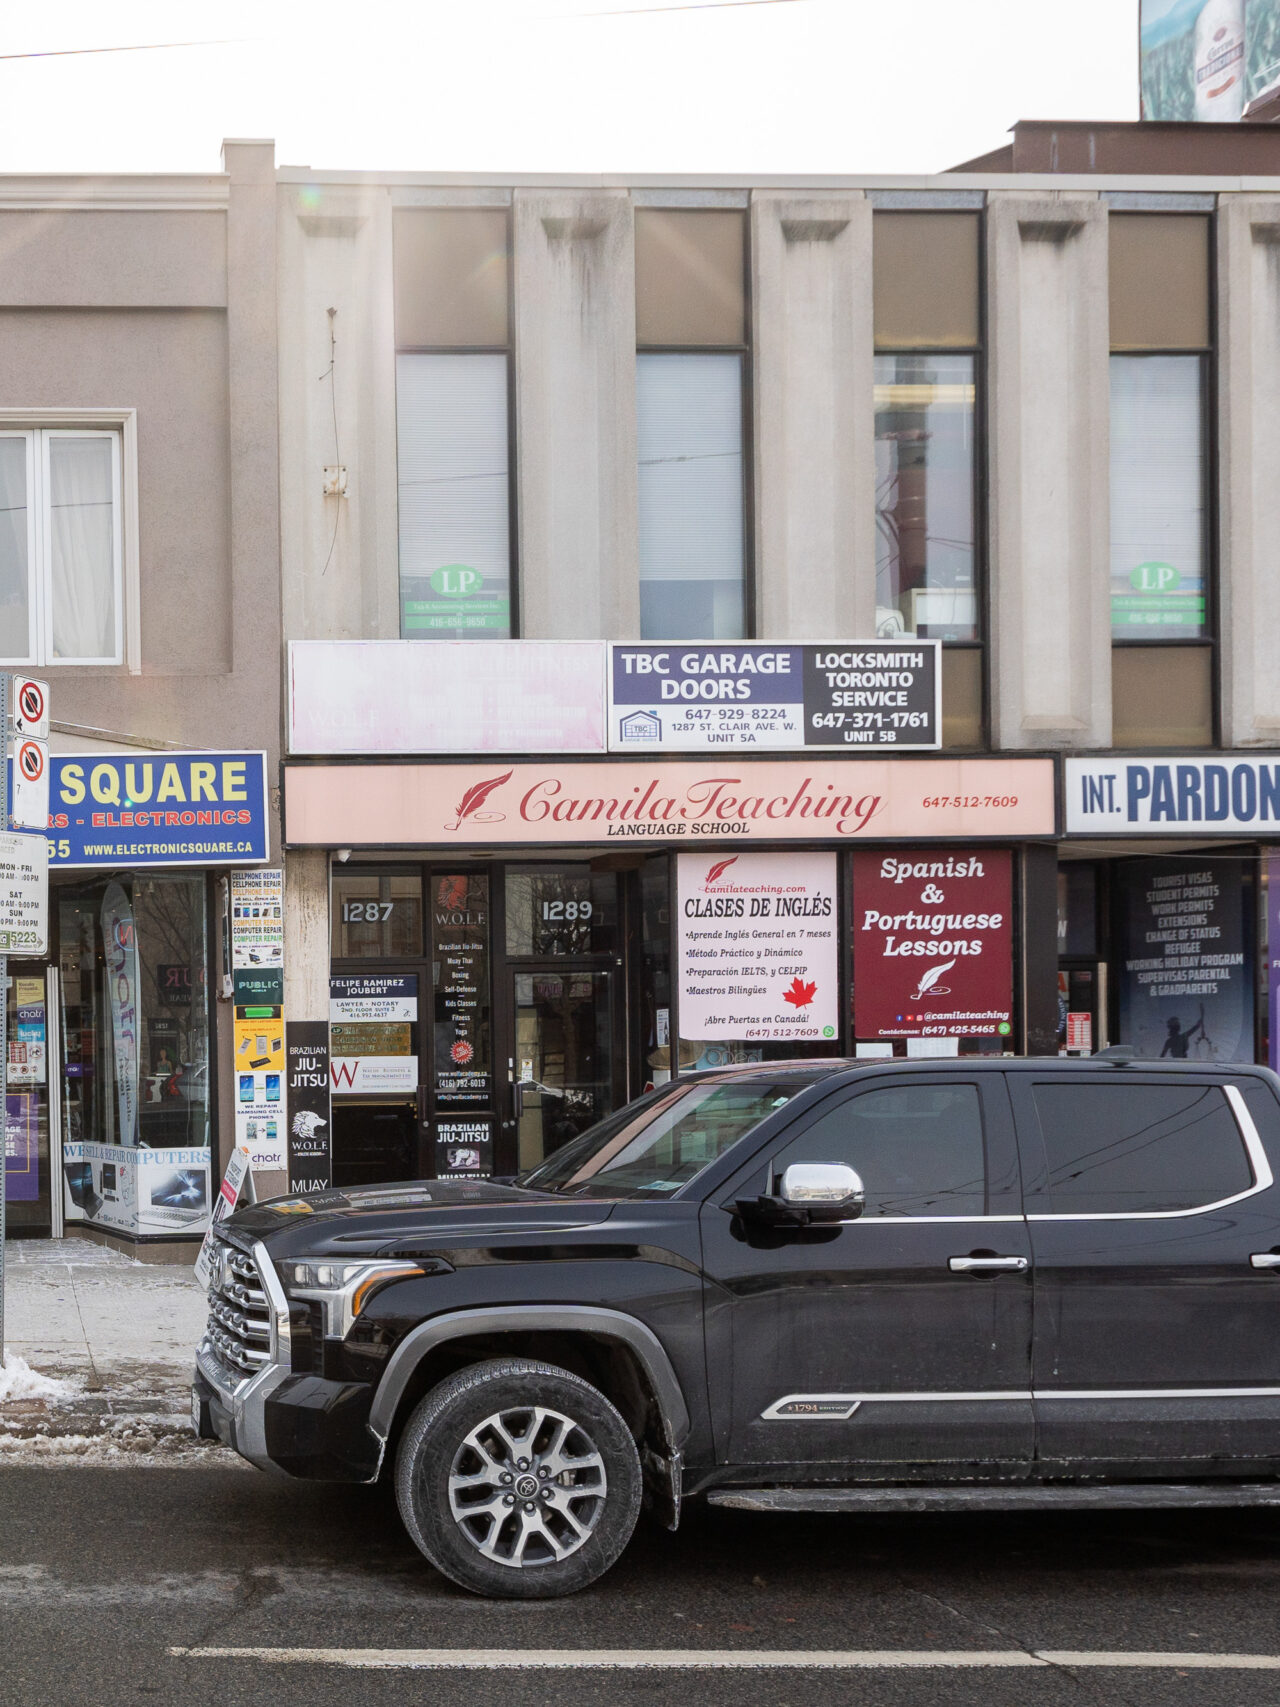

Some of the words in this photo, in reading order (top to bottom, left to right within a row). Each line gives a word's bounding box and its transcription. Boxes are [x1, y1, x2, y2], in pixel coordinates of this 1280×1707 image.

[441, 571, 475, 593] LP
[1141, 568, 1174, 589] LP
[621, 653, 670, 674] TBC
[680, 653, 791, 674] GARAGE
[815, 652, 924, 669] LOCKSMITH
[826, 671, 914, 688] TORONTO
[661, 678, 752, 700] DOORS
[831, 691, 909, 707] SERVICE
[684, 708, 787, 720] 647-929-8224
[812, 712, 929, 729] 647-371-1761
[672, 723, 695, 732] 1287
[699, 723, 714, 732] ST.
[719, 722, 750, 732] CLAIR
[754, 722, 779, 732] AVE.
[783, 722, 797, 732] W.
[707, 733, 736, 743] UNIT
[740, 733, 756, 743] 5A
[844, 731, 875, 742] UNIT
[879, 731, 897, 742] 5B
[59, 761, 248, 807] SQUARE
[1081, 774, 1122, 814] INT.
[1126, 763, 1280, 822] PARDON
[519, 779, 683, 822] Camila
[681, 777, 888, 834] Teaching
[922, 795, 1019, 808] 647-512-7609
[91, 809, 252, 828] ELECTRONICS
[607, 823, 687, 836] LANGUAGE
[690, 822, 750, 835] SCHOOL
[83, 841, 253, 856] WWW.ELECTRONICSQUARE.CA
[0, 862, 16, 871] MON
[21, 864, 33, 873] FRI
[880, 856, 985, 884] Spanish
[232, 872, 262, 880] CELLPHONE
[263, 872, 282, 880] REPAIR
[1152, 874, 1187, 888] TOURIST
[1187, 871, 1213, 885] VISAS
[232, 880, 262, 888] CELLPHONE
[263, 880, 282, 888] REPAIR
[704, 884, 806, 895] camilateaching.com
[9, 891, 23, 899] SAT
[232, 888, 262, 896] CELLPHONE
[263, 888, 282, 896] REPAIR
[920, 883, 945, 904] &
[1145, 888, 1182, 903] STUDENT
[1182, 884, 1220, 899] PERMITS
[543, 900, 593, 921] 1289
[684, 897, 745, 918] CLASES
[749, 897, 771, 917] DE
[774, 891, 832, 917] INGLÉS
[1151, 903, 1177, 916] WORK
[1178, 899, 1214, 913] PERMITS
[9, 909, 23, 917] SUN
[343, 902, 394, 922] 1287
[436, 912, 486, 925] W.O.L.F.
[263, 919, 282, 927] REPAIR
[861, 910, 1003, 935] Portuguese
[1157, 913, 1208, 929] EXTENSIONS
[10, 931, 37, 943] 5223
[724, 929, 750, 941] Inglés
[752, 929, 785, 939] General
[787, 930, 797, 938] en
[806, 930, 832, 938] meses
[1145, 929, 1177, 943] CHANGE
[1178, 928, 1190, 940] OF
[1190, 926, 1221, 940] STATUS
[720, 948, 755, 958] Práctico
[764, 947, 803, 957] Dinámico
[882, 936, 983, 957] Lessons
[1164, 941, 1201, 955] REFUGEE
[1125, 957, 1164, 971] WORKING
[1164, 955, 1199, 969] HOLIDAY
[1200, 952, 1244, 967] PROGRAM
[741, 967, 768, 977] IELTS,
[778, 966, 808, 976] CELPIP
[1137, 969, 1188, 984] SUPERVISAS
[1188, 967, 1231, 981] PARENTAL
[238, 980, 279, 989] PUBLIC
[330, 980, 360, 988] FELIPE
[363, 979, 405, 987] RAMIREZ
[347, 986, 388, 996] JOUBERT
[728, 985, 767, 996] Bilingües
[19, 1010, 42, 1019] chatr
[704, 1015, 727, 1026] ¡Abre
[728, 1015, 760, 1025] Puertas
[762, 1016, 772, 1024] en
[774, 1014, 810, 1024] Canadá!
[923, 1010, 1010, 1022] @camilateaching
[745, 1029, 770, 1038] (647)
[773, 1028, 819, 1037] 512-7609
[921, 1025, 947, 1036] (647)
[948, 1024, 996, 1035] 425-5465
[289, 1046, 327, 1055] BRAZILIAN
[295, 1057, 322, 1071] JIU-
[289, 1073, 328, 1088] JITSU
[331, 1061, 360, 1089] W
[439, 1079, 456, 1088] (416)
[437, 1123, 489, 1132] BRAZILIAN
[437, 1132, 490, 1143] JIU-JITSU
[291, 1141, 328, 1151] W.O.L.F.
[251, 1153, 282, 1163] chatr
[291, 1179, 328, 1193] MUAY
[794, 1404, 818, 1412] 1794
